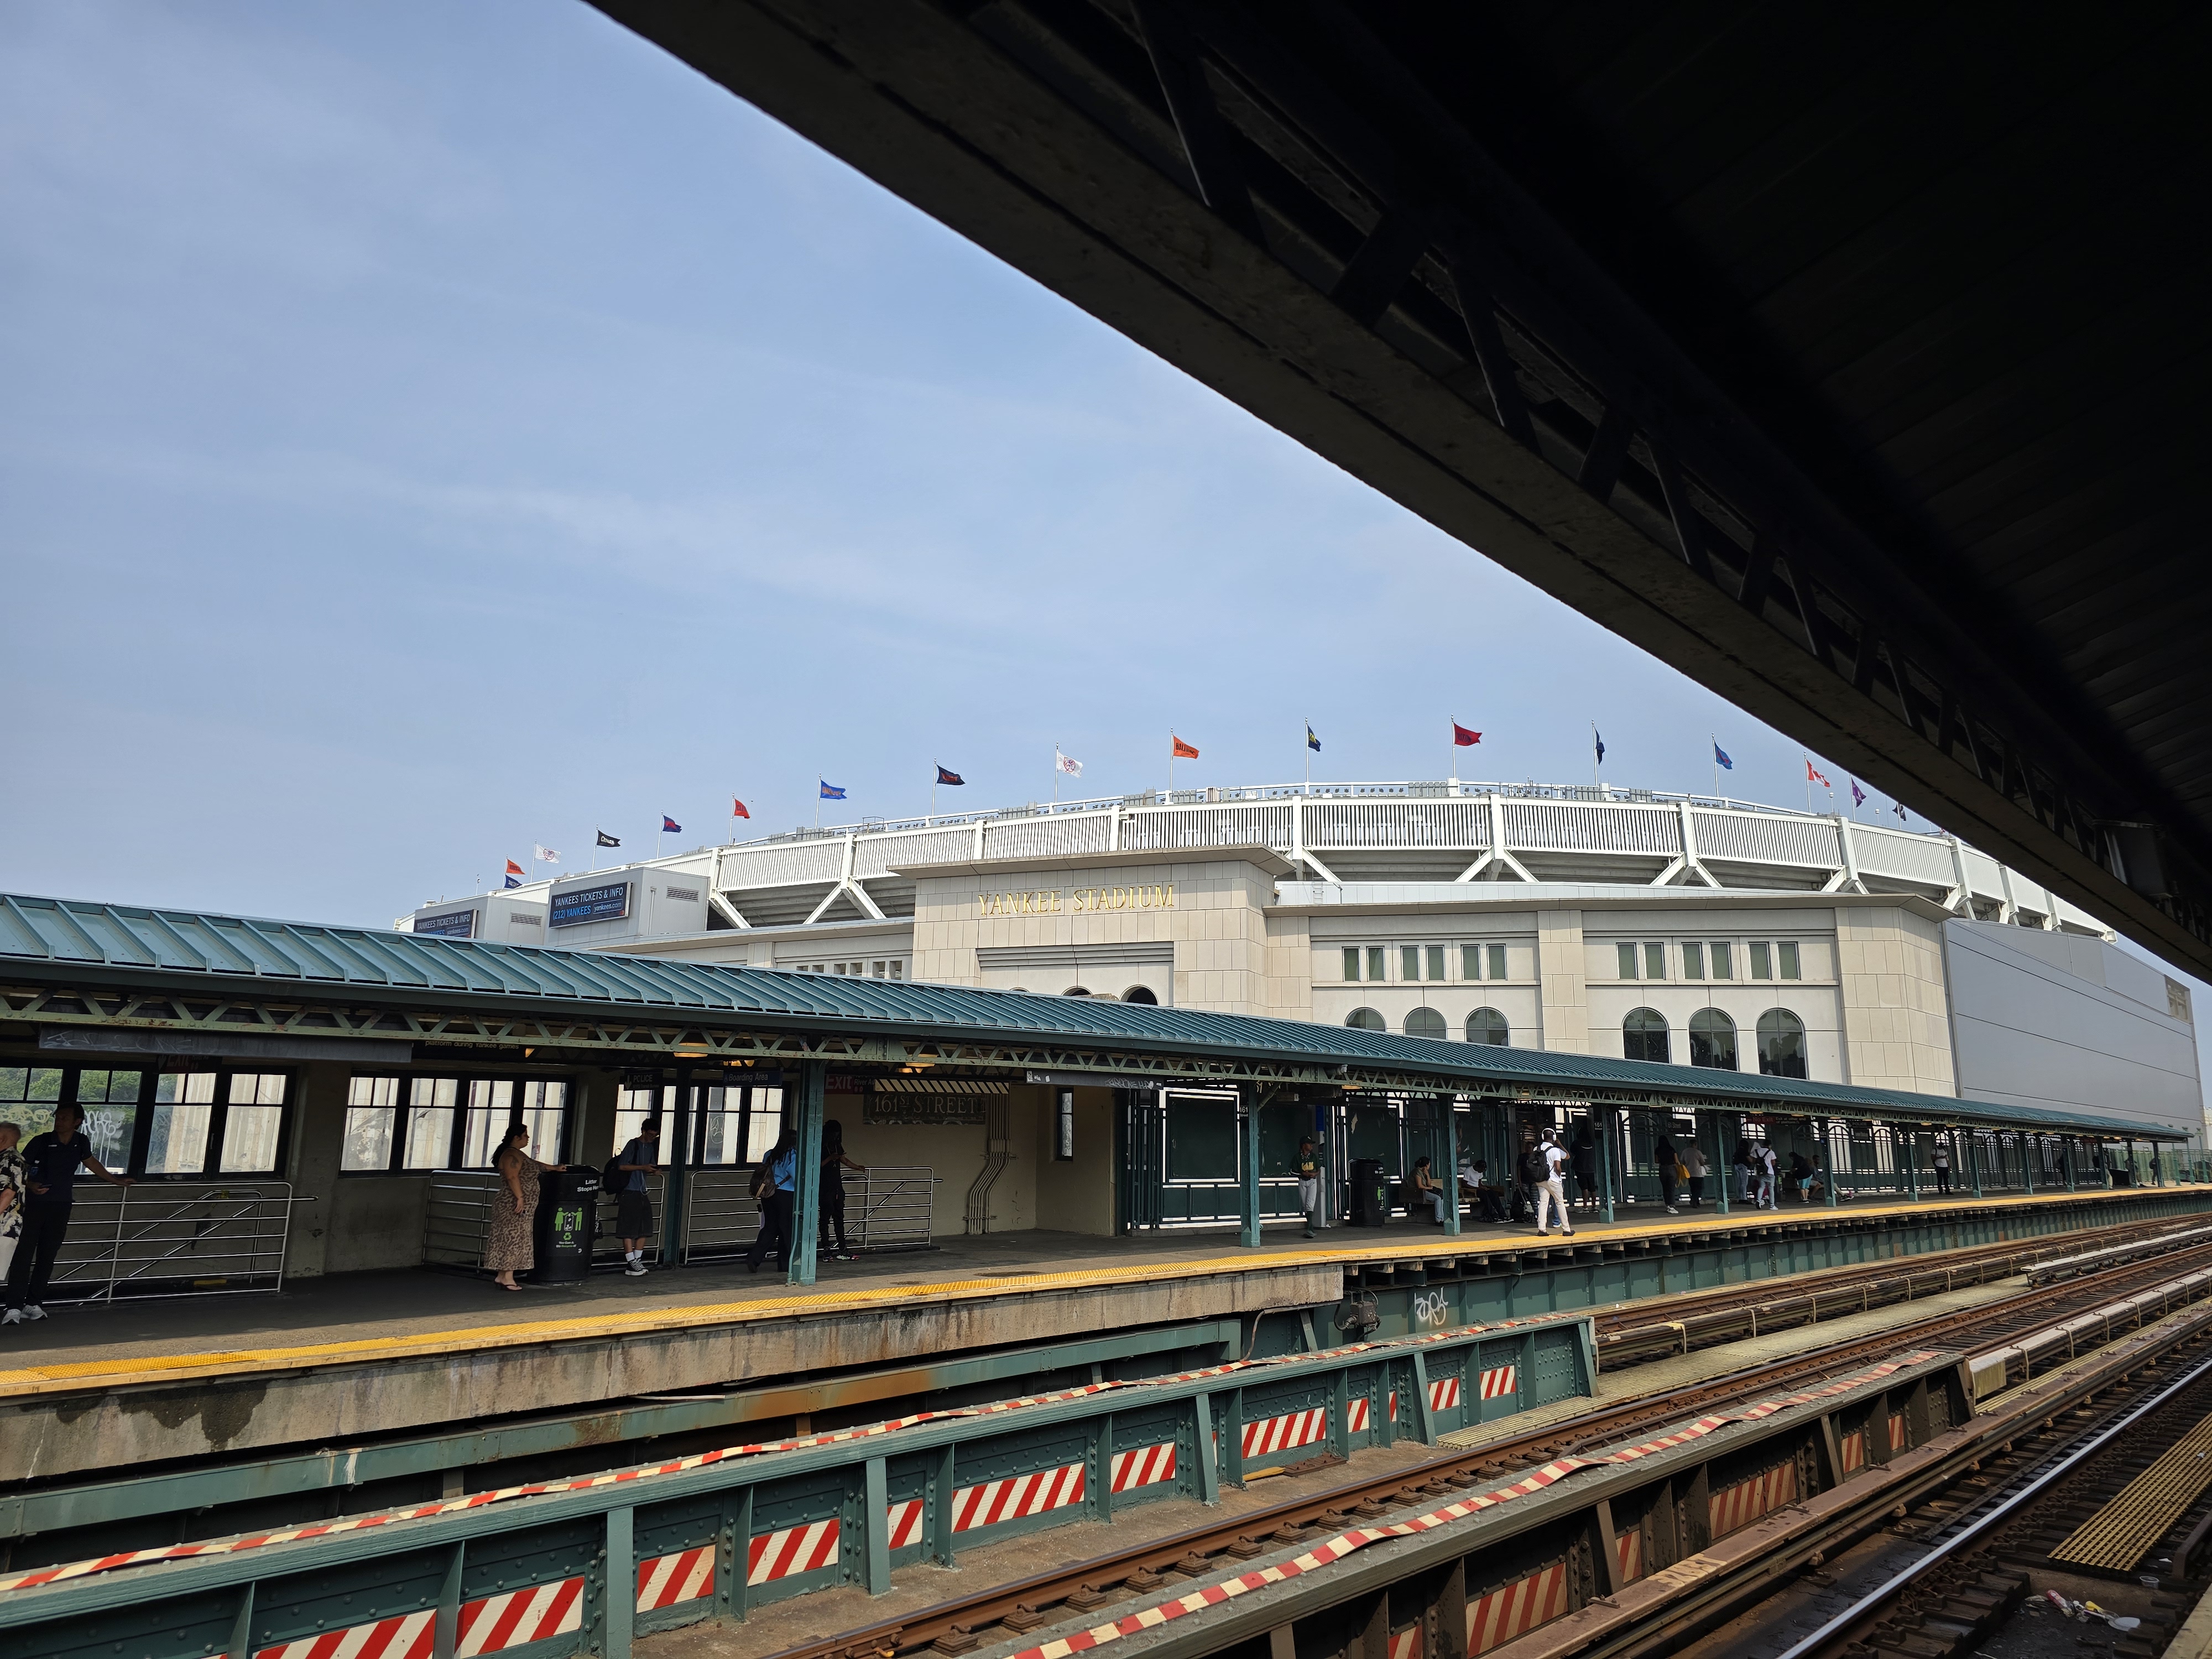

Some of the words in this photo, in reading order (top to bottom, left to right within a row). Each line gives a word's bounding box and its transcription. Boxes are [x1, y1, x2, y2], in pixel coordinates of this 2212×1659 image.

[555, 895, 579, 907] YANKEES
[580, 890, 602, 903] TICKETS
[604, 889, 608, 899] &
[609, 886, 624, 898] INFO
[978, 890, 1062, 915] YANKEE
[1072, 885, 1175, 911] STADIUM
[552, 909, 566, 921] (212)
[566, 905, 591, 917] YANKEES
[593, 902, 622, 912] yankees.com
[417, 920, 436, 930] YANKEES
[436, 916, 454, 927] TICKETS
[455, 916, 458, 924] &
[459, 914, 471, 923] INFO
[633, 1074, 653, 1083] POLICE
[728, 1073, 753, 1083] Boarding
[754, 1073, 768, 1081] Area
[825, 1075, 852, 1089] Exit
[914, 1095, 978, 1114] STREET
